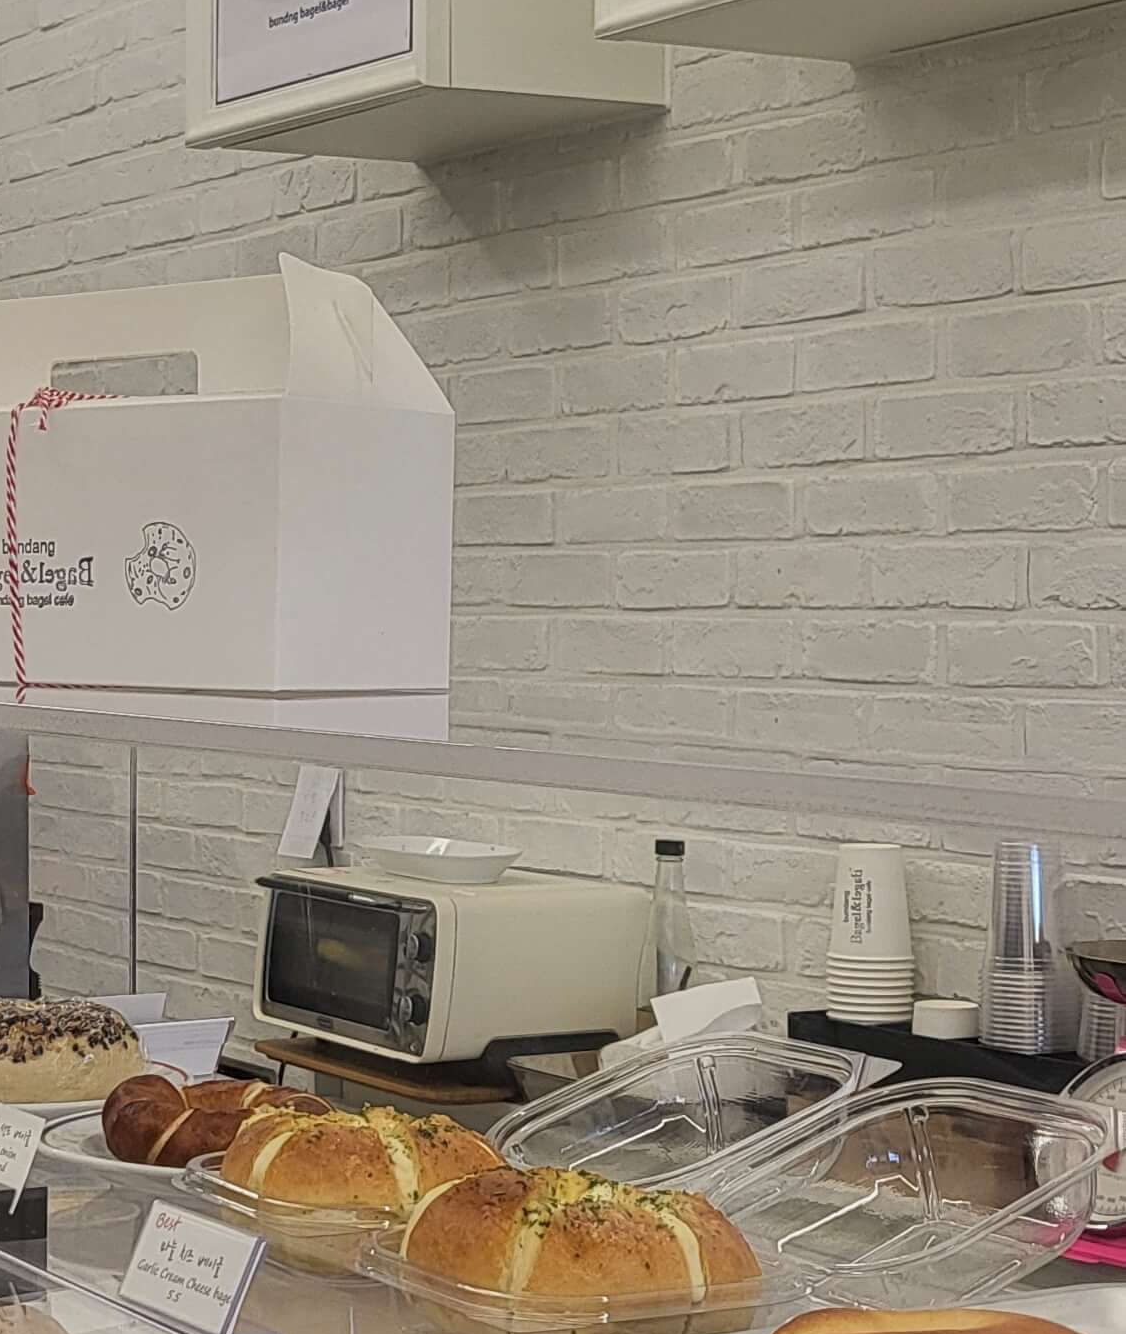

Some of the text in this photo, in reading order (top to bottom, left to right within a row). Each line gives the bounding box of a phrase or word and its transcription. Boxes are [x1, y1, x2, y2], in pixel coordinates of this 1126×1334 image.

[2, 539, 55, 557] bndang
[155, 1212, 183, 1231] Best
[159, 1267, 185, 1285] Cream
[186, 1277, 212, 1296] Cheese
